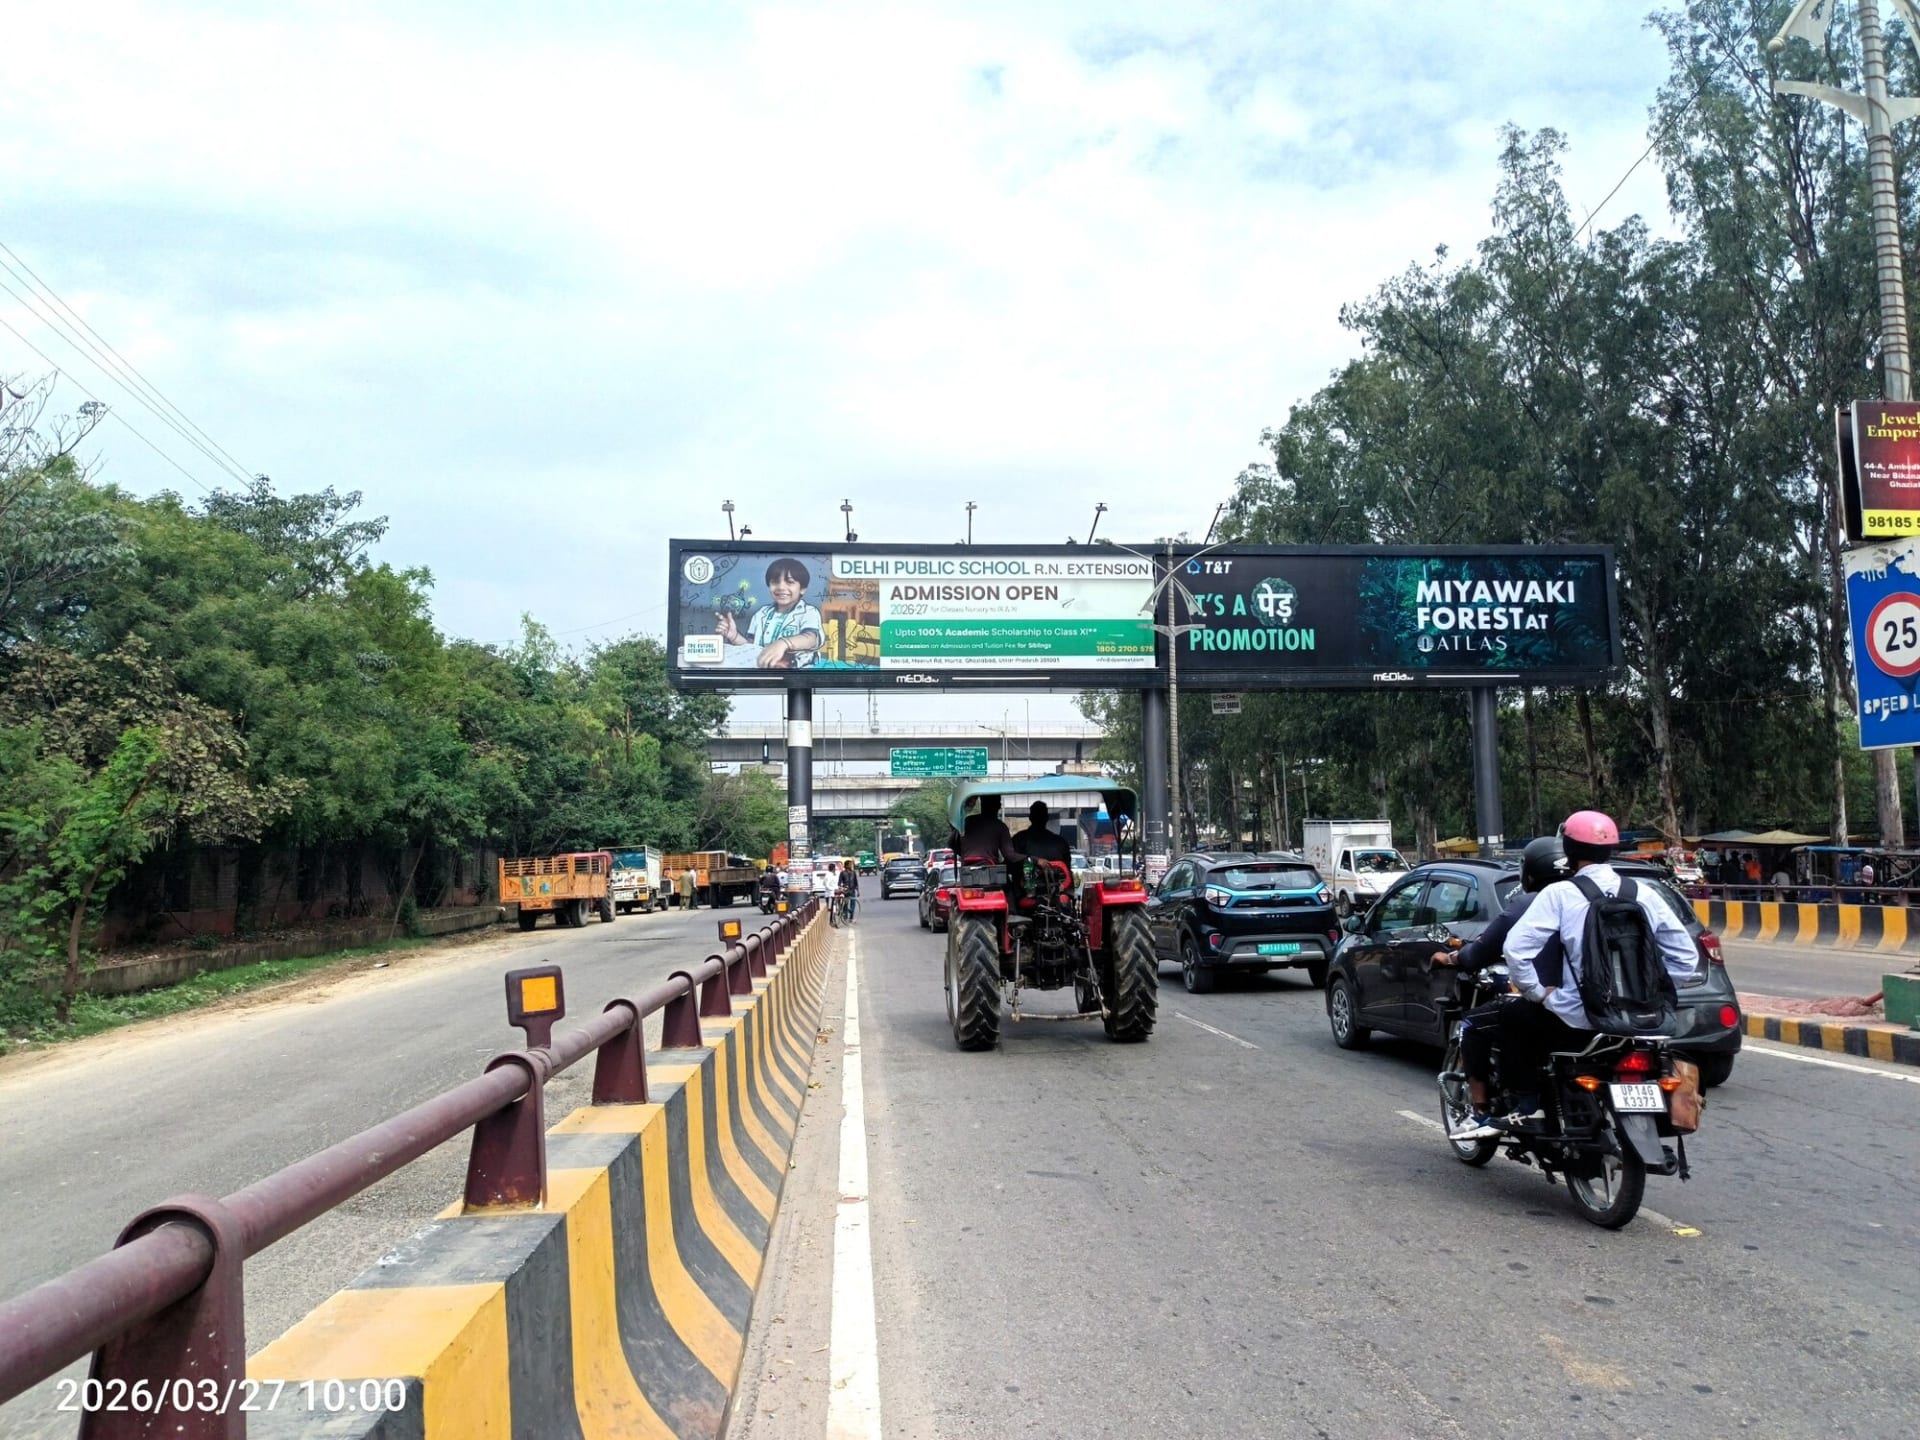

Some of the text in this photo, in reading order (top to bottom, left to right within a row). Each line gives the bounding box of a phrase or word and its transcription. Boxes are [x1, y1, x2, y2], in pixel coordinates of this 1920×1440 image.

[1868, 516, 1912, 528] 98185
[840, 560, 1149, 575] DELHI PUBLIC SCHOOL R.N. EXTENSION
[1204, 561, 1233, 574] T&T
[890, 585, 1058, 601] ADMISSION OPEN
[1415, 580, 1576, 603] MIYAWAKI
[890, 603, 928, 615] 2026-27
[1191, 593, 1247, 616] T'S A
[1256, 583, 1294, 623] पेड़
[1416, 607, 1549, 630] FOREST AT
[895, 628, 917, 637] Upto
[918, 628, 943, 637] 100%
[945, 628, 989, 637] Academic
[991, 627, 1042, 637] Scholarship
[1043, 628, 1052, 636] to
[1054, 628, 1078, 636] Class
[1190, 628, 1316, 651] PROMOTION
[1883, 617, 1917, 653] 25
[1437, 635, 1508, 651] ATLAS
[1864, 695, 1909, 715] SPEED
[1624, 1096, 1657, 1108] K3373
